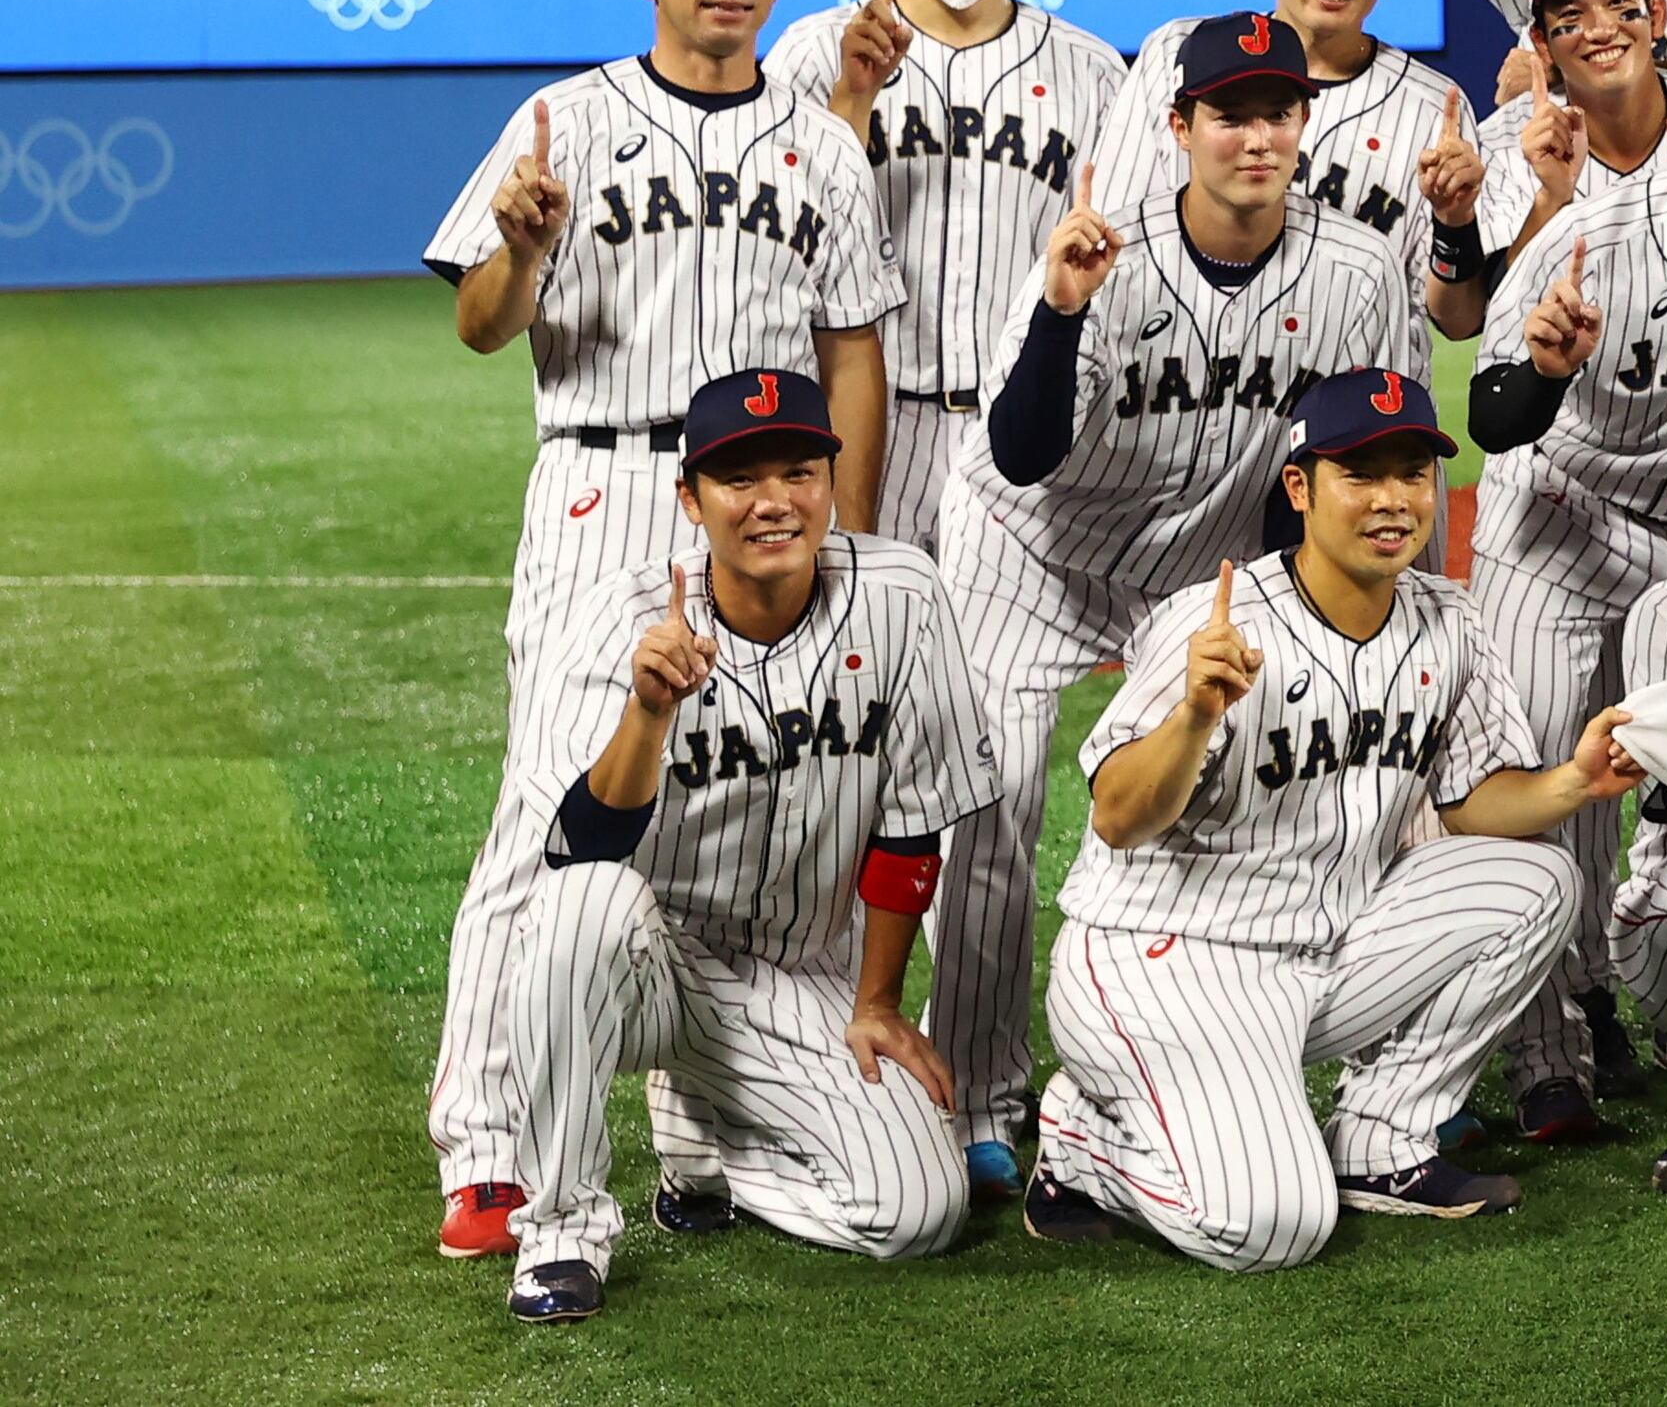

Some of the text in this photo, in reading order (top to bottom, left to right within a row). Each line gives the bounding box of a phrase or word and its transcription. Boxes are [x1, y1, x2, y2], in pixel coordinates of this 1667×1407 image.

[1238, 15, 1271, 55] J
[595, 171, 826, 269] JAPAN
[744, 373, 780, 417] J
[1370, 371, 1404, 415] J
[670, 698, 890, 789] JAPAN
[1257, 709, 1444, 791] JAPAN
